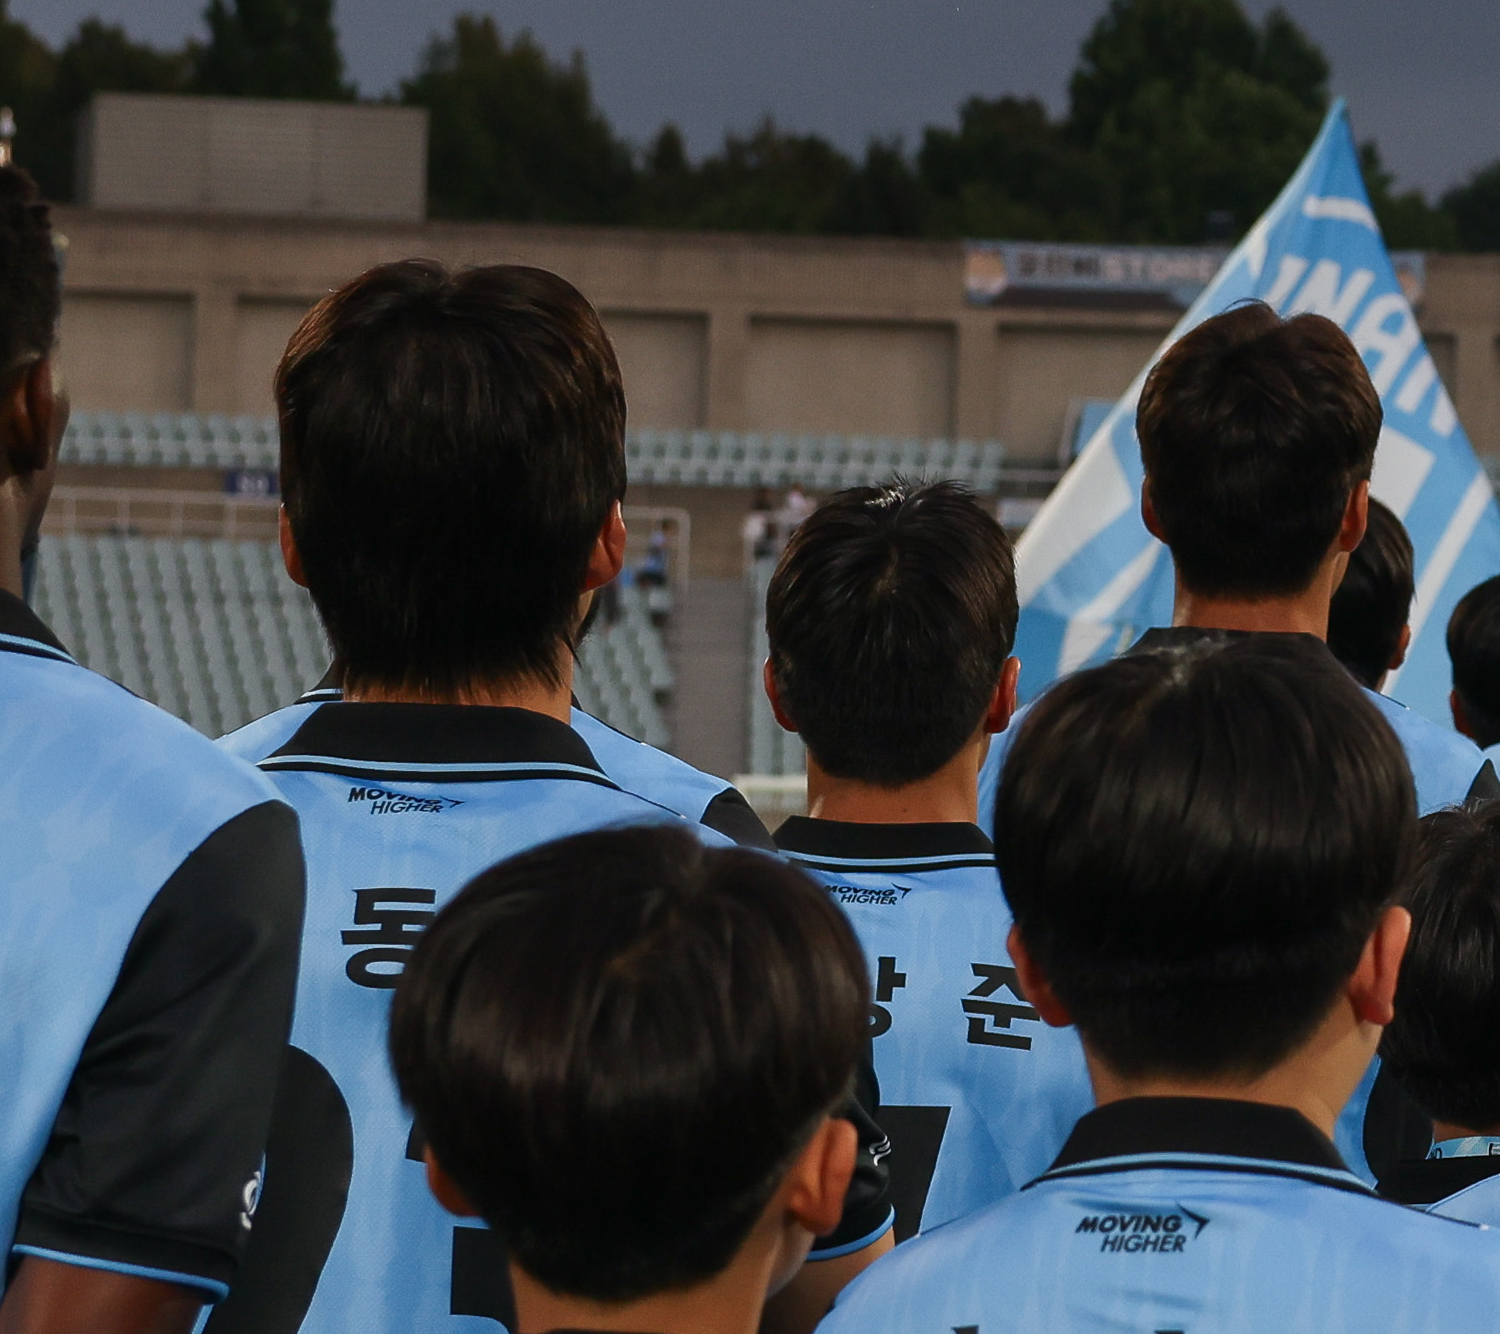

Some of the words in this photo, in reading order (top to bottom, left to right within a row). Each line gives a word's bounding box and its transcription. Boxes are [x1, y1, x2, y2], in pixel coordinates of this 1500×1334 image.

[348, 787, 443, 804] MOVING
[370, 800, 445, 815] HIGHER
[824, 884, 896, 897] MOVING
[840, 894, 898, 906] HIGHER
[1075, 1213, 1182, 1235] MOVING
[1100, 1233, 1187, 1254] HIGHER
